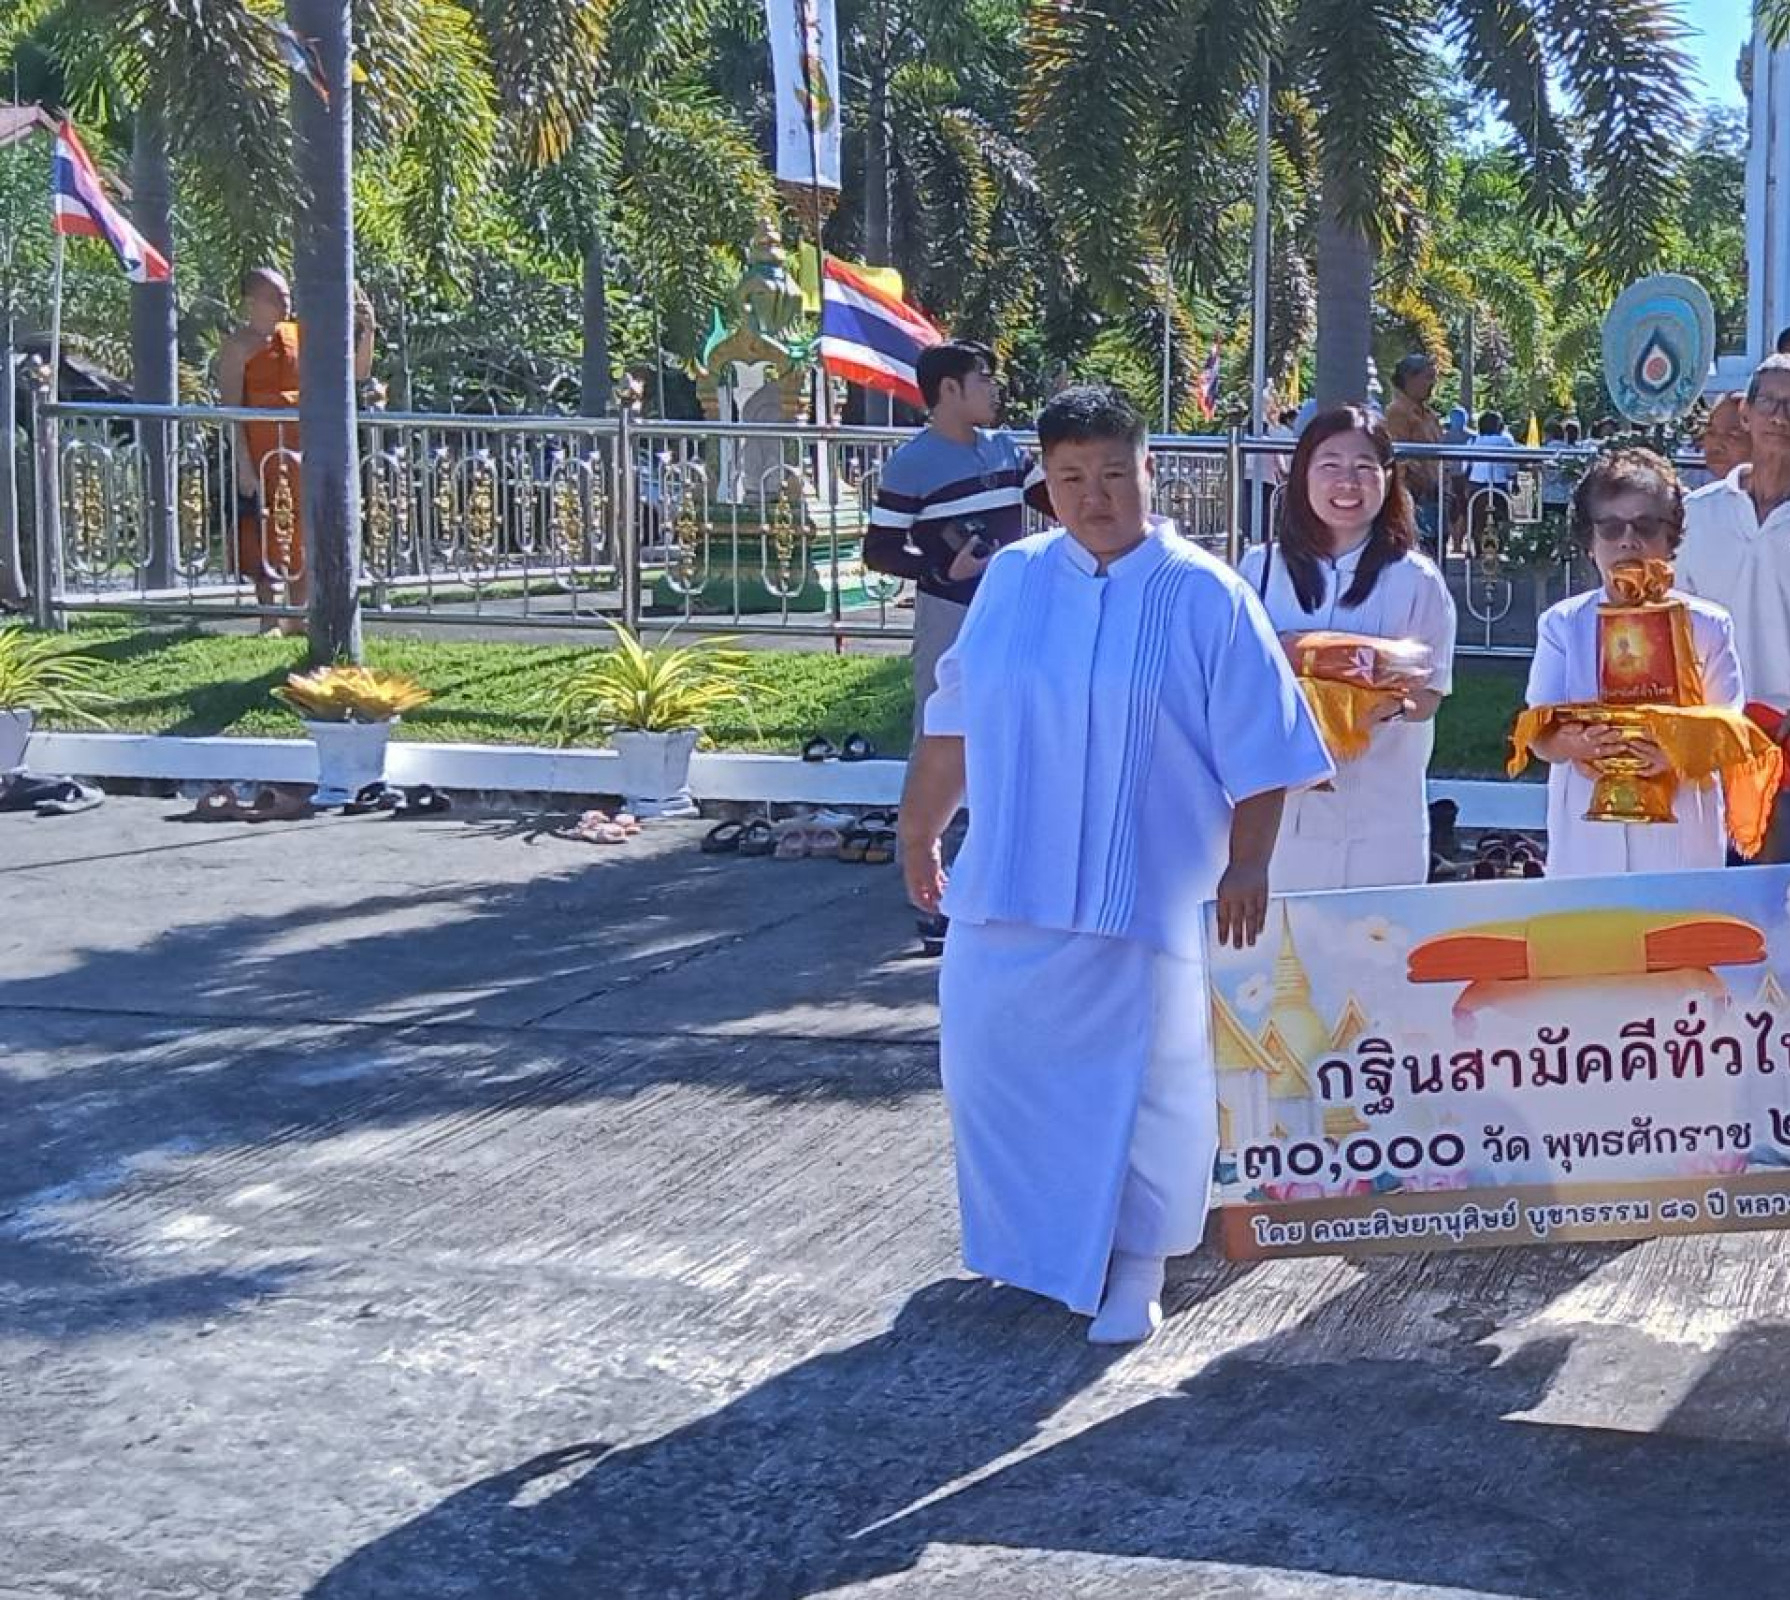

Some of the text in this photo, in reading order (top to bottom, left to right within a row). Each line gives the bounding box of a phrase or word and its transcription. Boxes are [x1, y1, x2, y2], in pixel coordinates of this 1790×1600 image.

[1243, 1132, 1466, 1183] ๓๐,๐๐๐
[1481, 1124, 1531, 1164] วัด
[1542, 1116, 1752, 1174] พุทธศักราช
[1254, 1217, 1304, 1245] โดย
[1313, 1199, 1518, 1240] คณะศิษยานุศิษย์
[1527, 1202, 1651, 1235] บูชาธรรม
[1659, 1200, 1698, 1220] ๘๑
[1706, 1190, 1728, 1217] ปี
